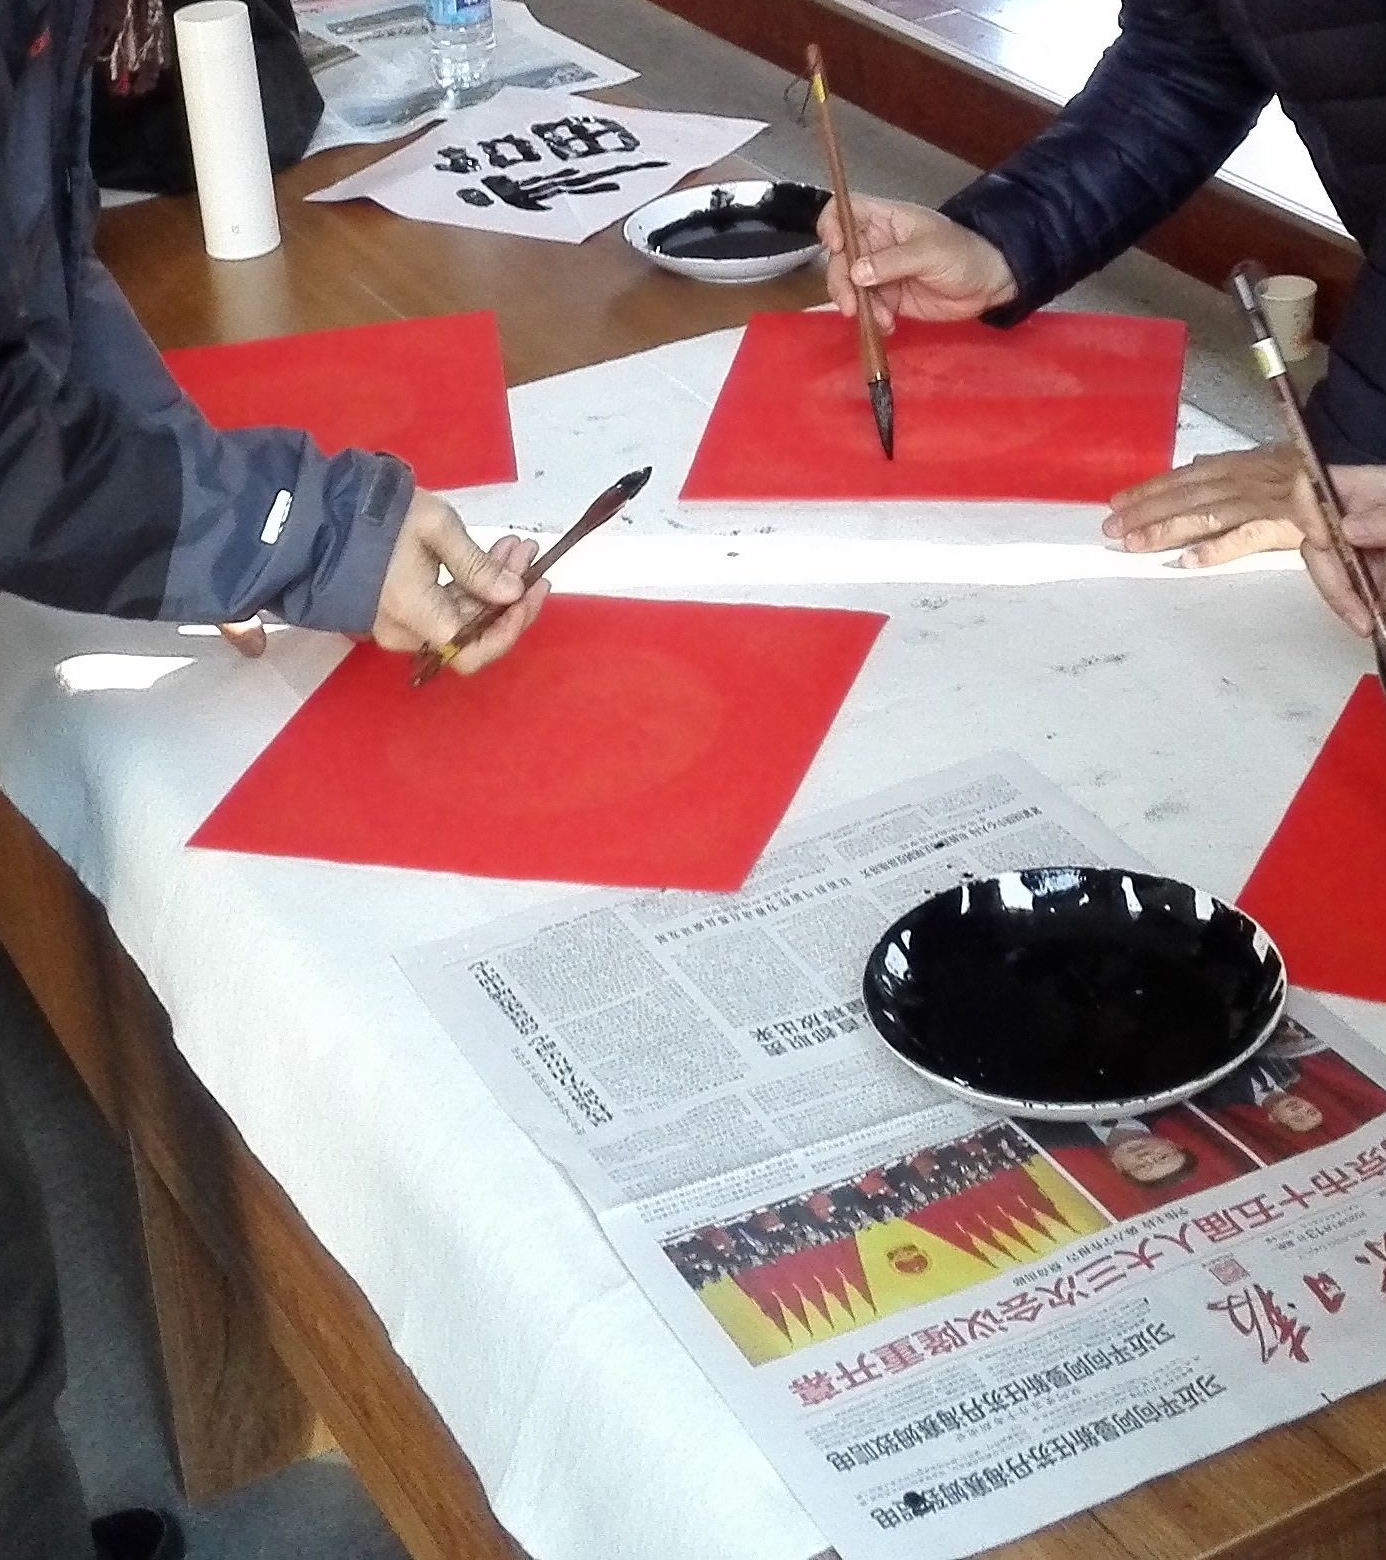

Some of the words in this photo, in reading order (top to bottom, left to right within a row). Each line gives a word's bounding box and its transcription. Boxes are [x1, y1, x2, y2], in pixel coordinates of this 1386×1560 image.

[760, 1012, 874, 1056] 首都职责
[825, 1322, 1175, 1472] 习近平向阿曼新任苏丹海赛姆致唁电
